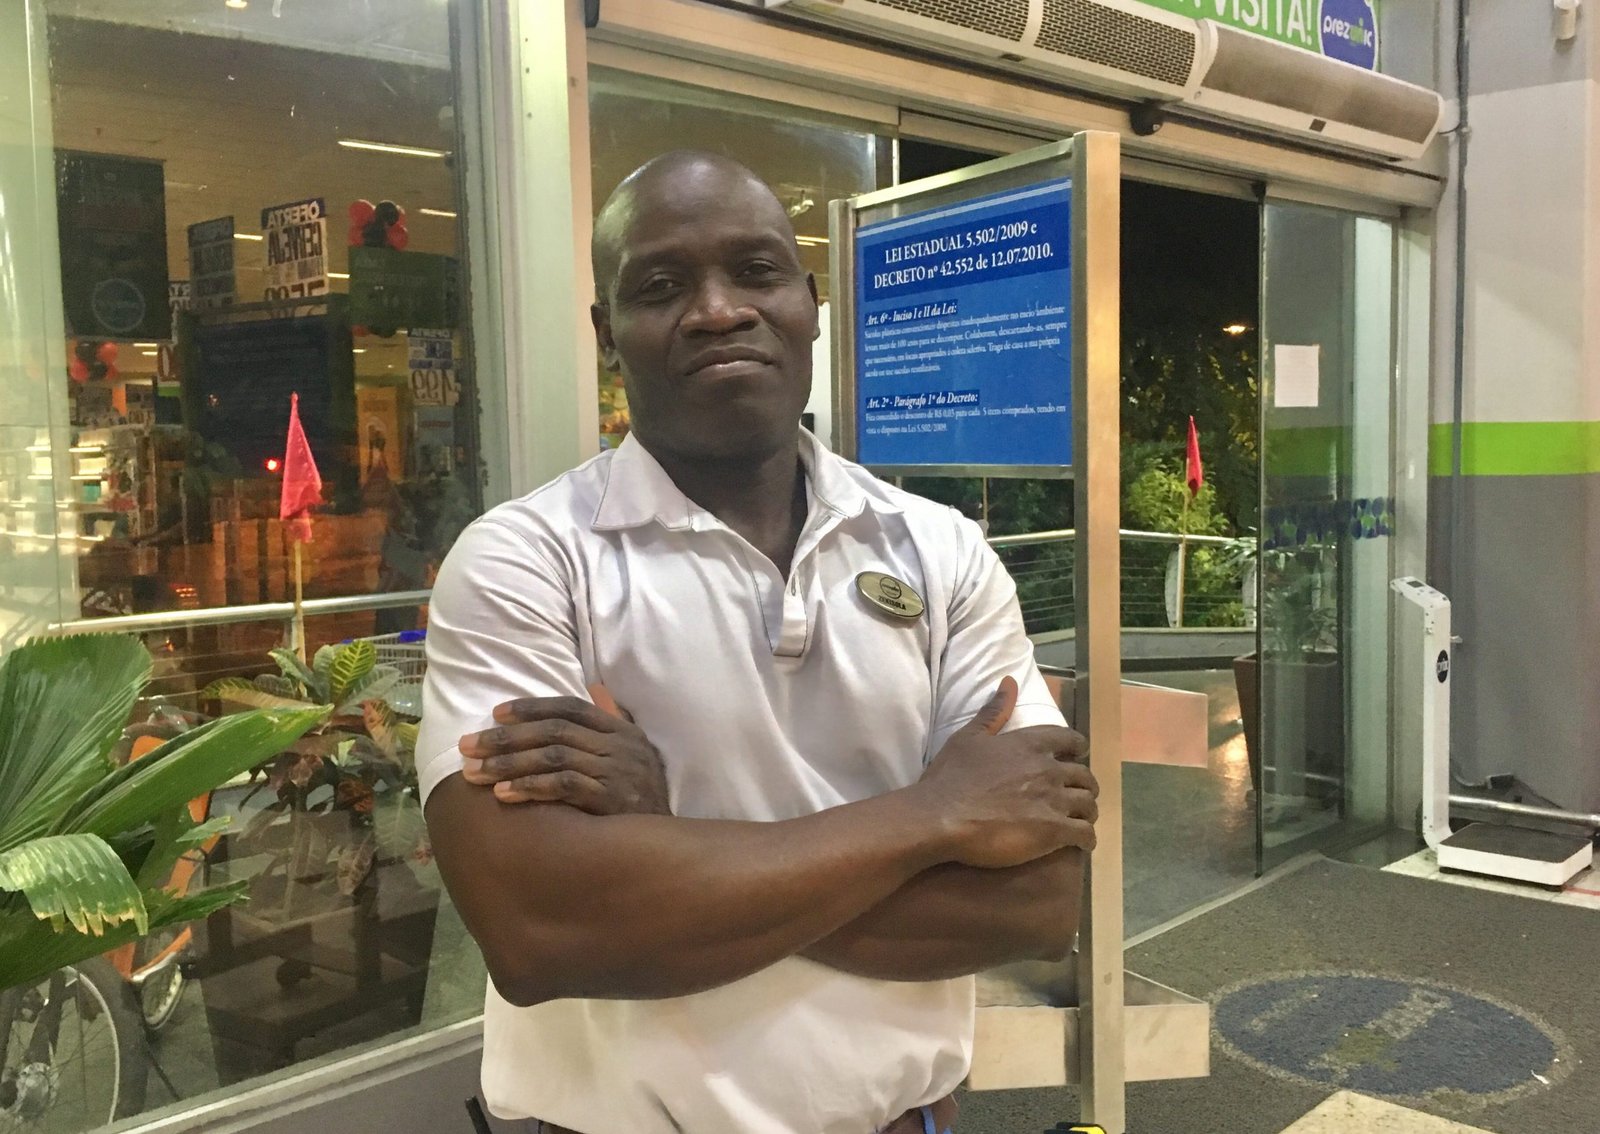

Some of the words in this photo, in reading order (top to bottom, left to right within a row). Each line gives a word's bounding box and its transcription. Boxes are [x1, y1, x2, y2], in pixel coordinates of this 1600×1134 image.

[886, 247, 902, 264] LEI
[904, 234, 964, 260] ESTADUAL
[966, 220, 1028, 248] 5.502/2009
[1031, 223, 1037, 234] e
[874, 266, 926, 289] DECRETO
[940, 257, 974, 276] 42.552
[976, 253, 988, 270] de
[992, 242, 1053, 267] 12.07.2010.
[866, 315, 879, 326] Art.
[893, 310, 913, 322] Inciso
[931, 304, 941, 316] da
[942, 303, 957, 315] Lei:
[867, 398, 880, 409] Art.
[894, 393, 927, 410] Parágrafo
[936, 392, 946, 404] do
[947, 392, 978, 404] Decreto:
